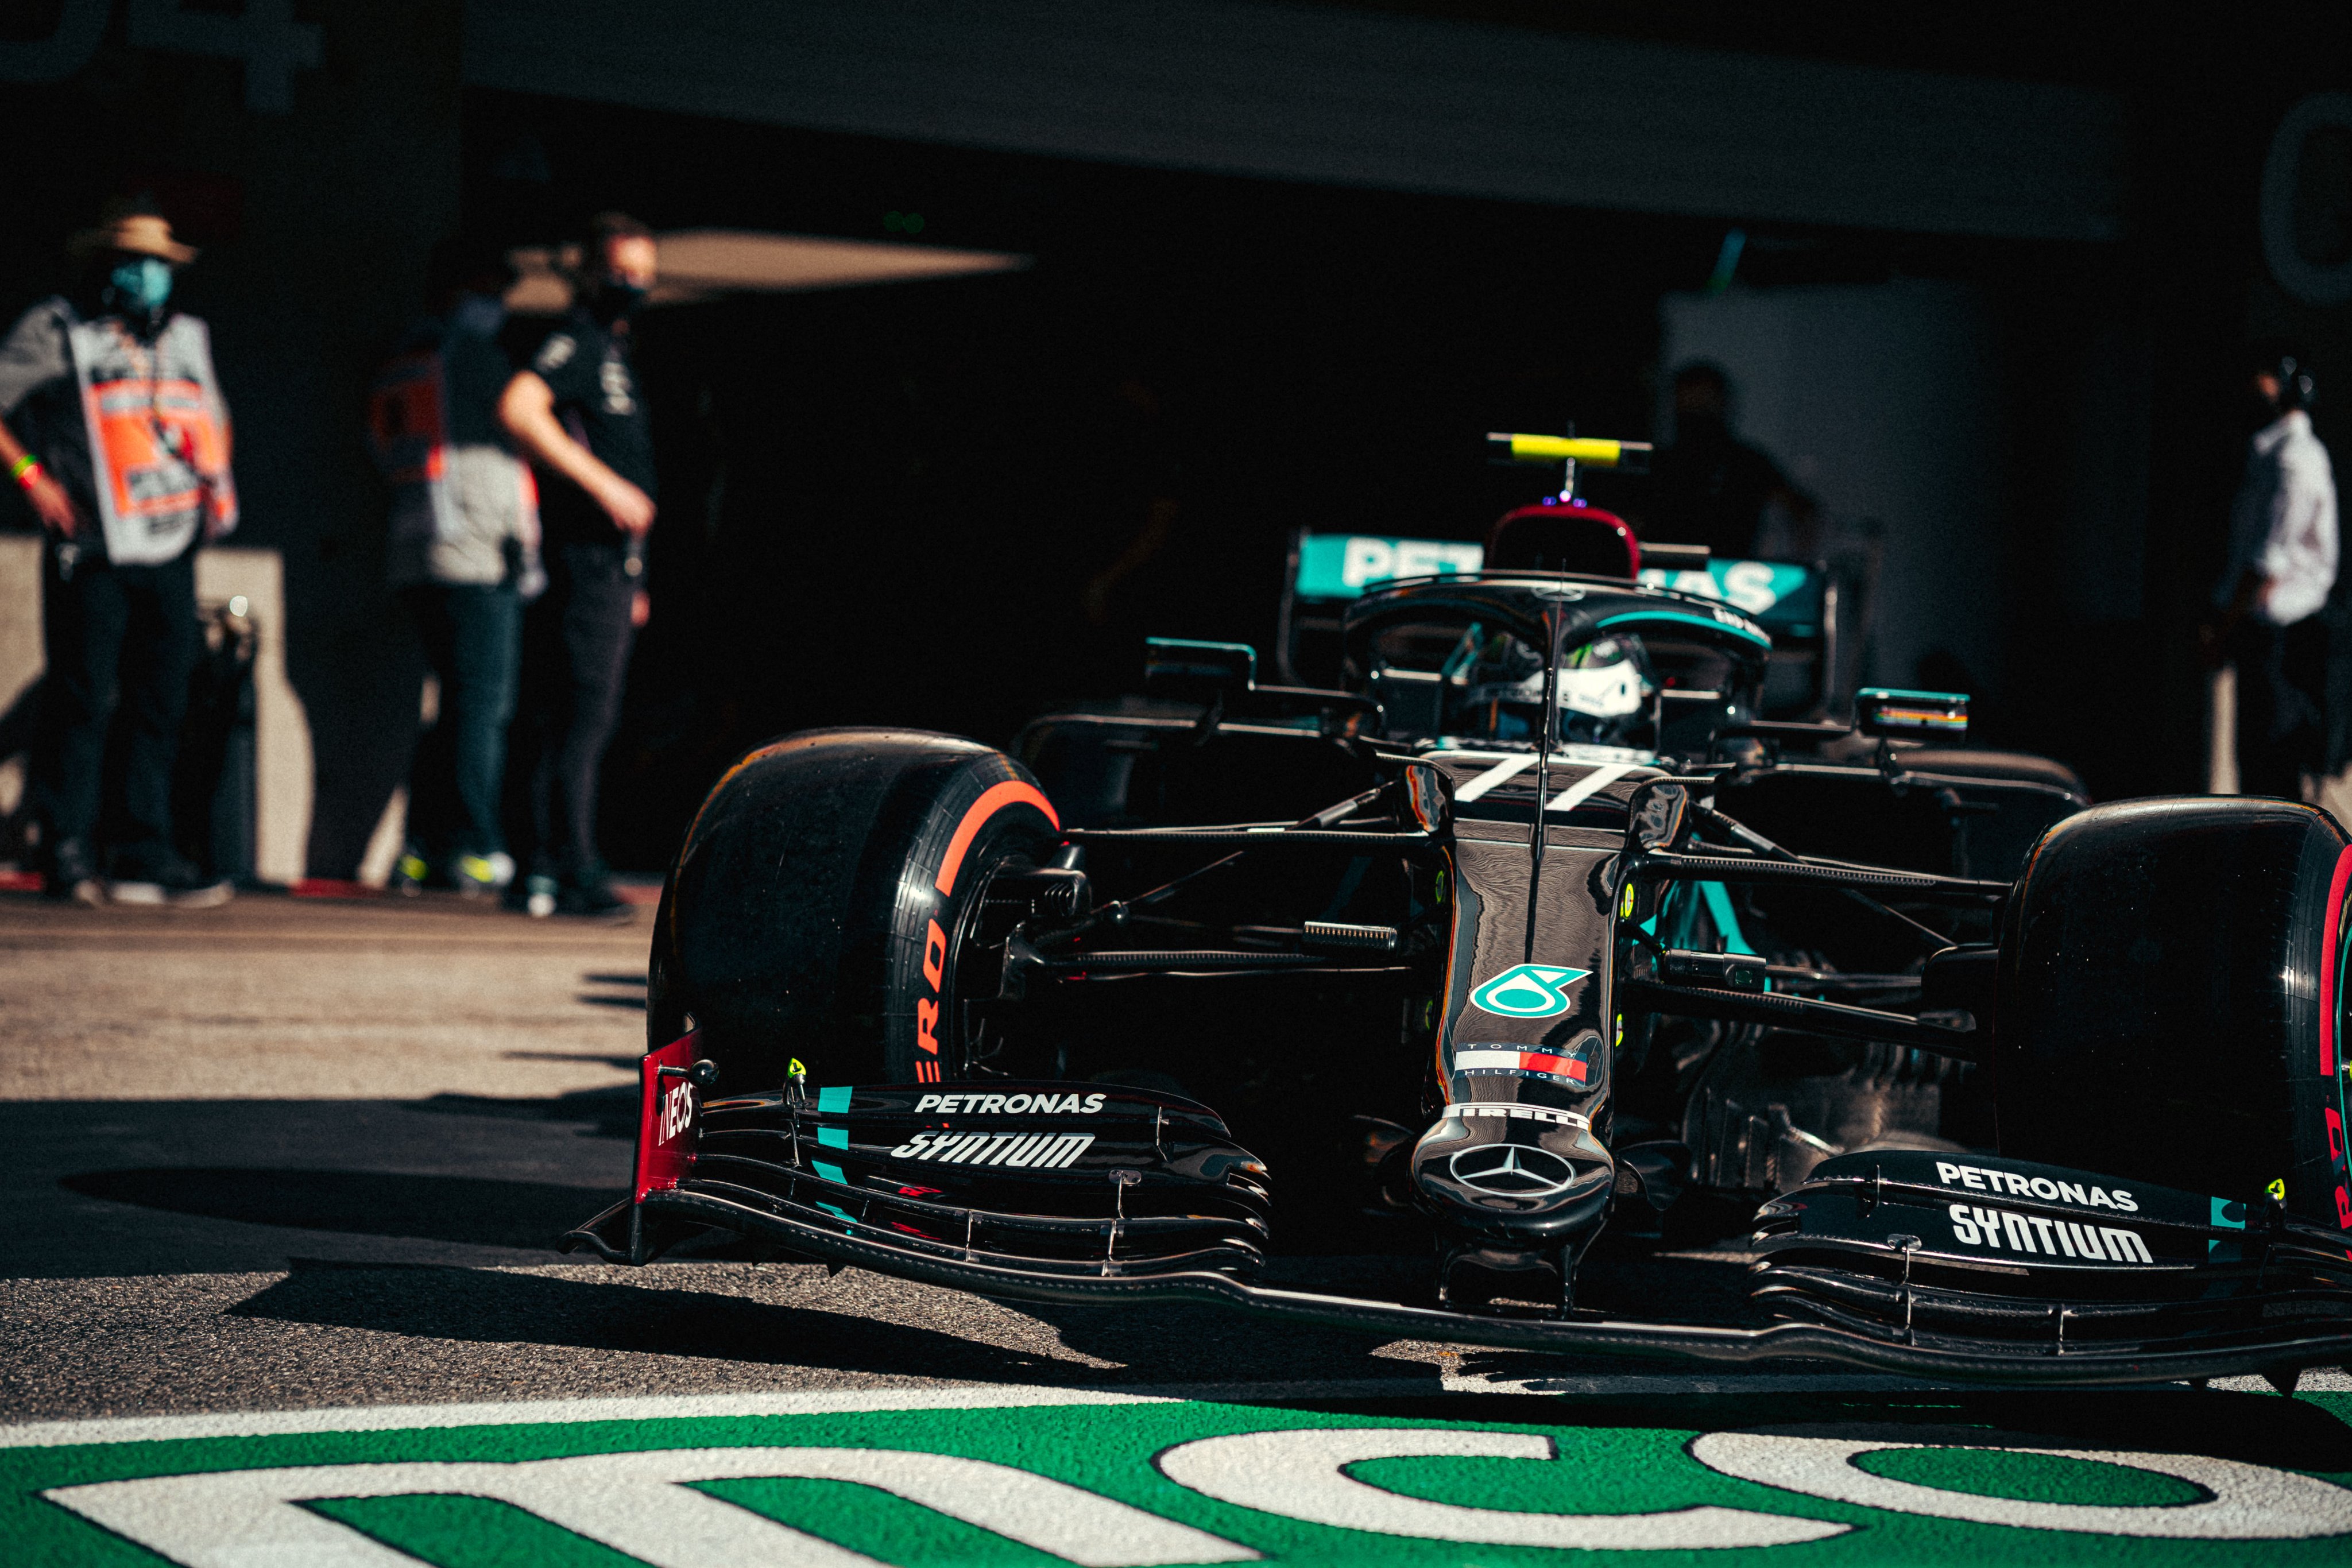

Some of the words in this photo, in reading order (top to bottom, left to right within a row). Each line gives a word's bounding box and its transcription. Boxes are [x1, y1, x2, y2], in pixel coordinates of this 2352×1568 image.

[1453, 751, 1646, 812] 77
[1467, 1043, 1577, 1058] TOMMY
[1464, 1068, 1576, 1086] HILFIGER
[657, 1082, 693, 1147] INEOS
[914, 1093, 1107, 1114] PETRONAS
[1441, 1101, 1591, 1131] PIRELLI
[890, 1130, 1096, 1168] SYNTIUM
[1935, 1161, 2139, 1212] PETRONAS
[1948, 1203, 2154, 1264] SYNTIUM
